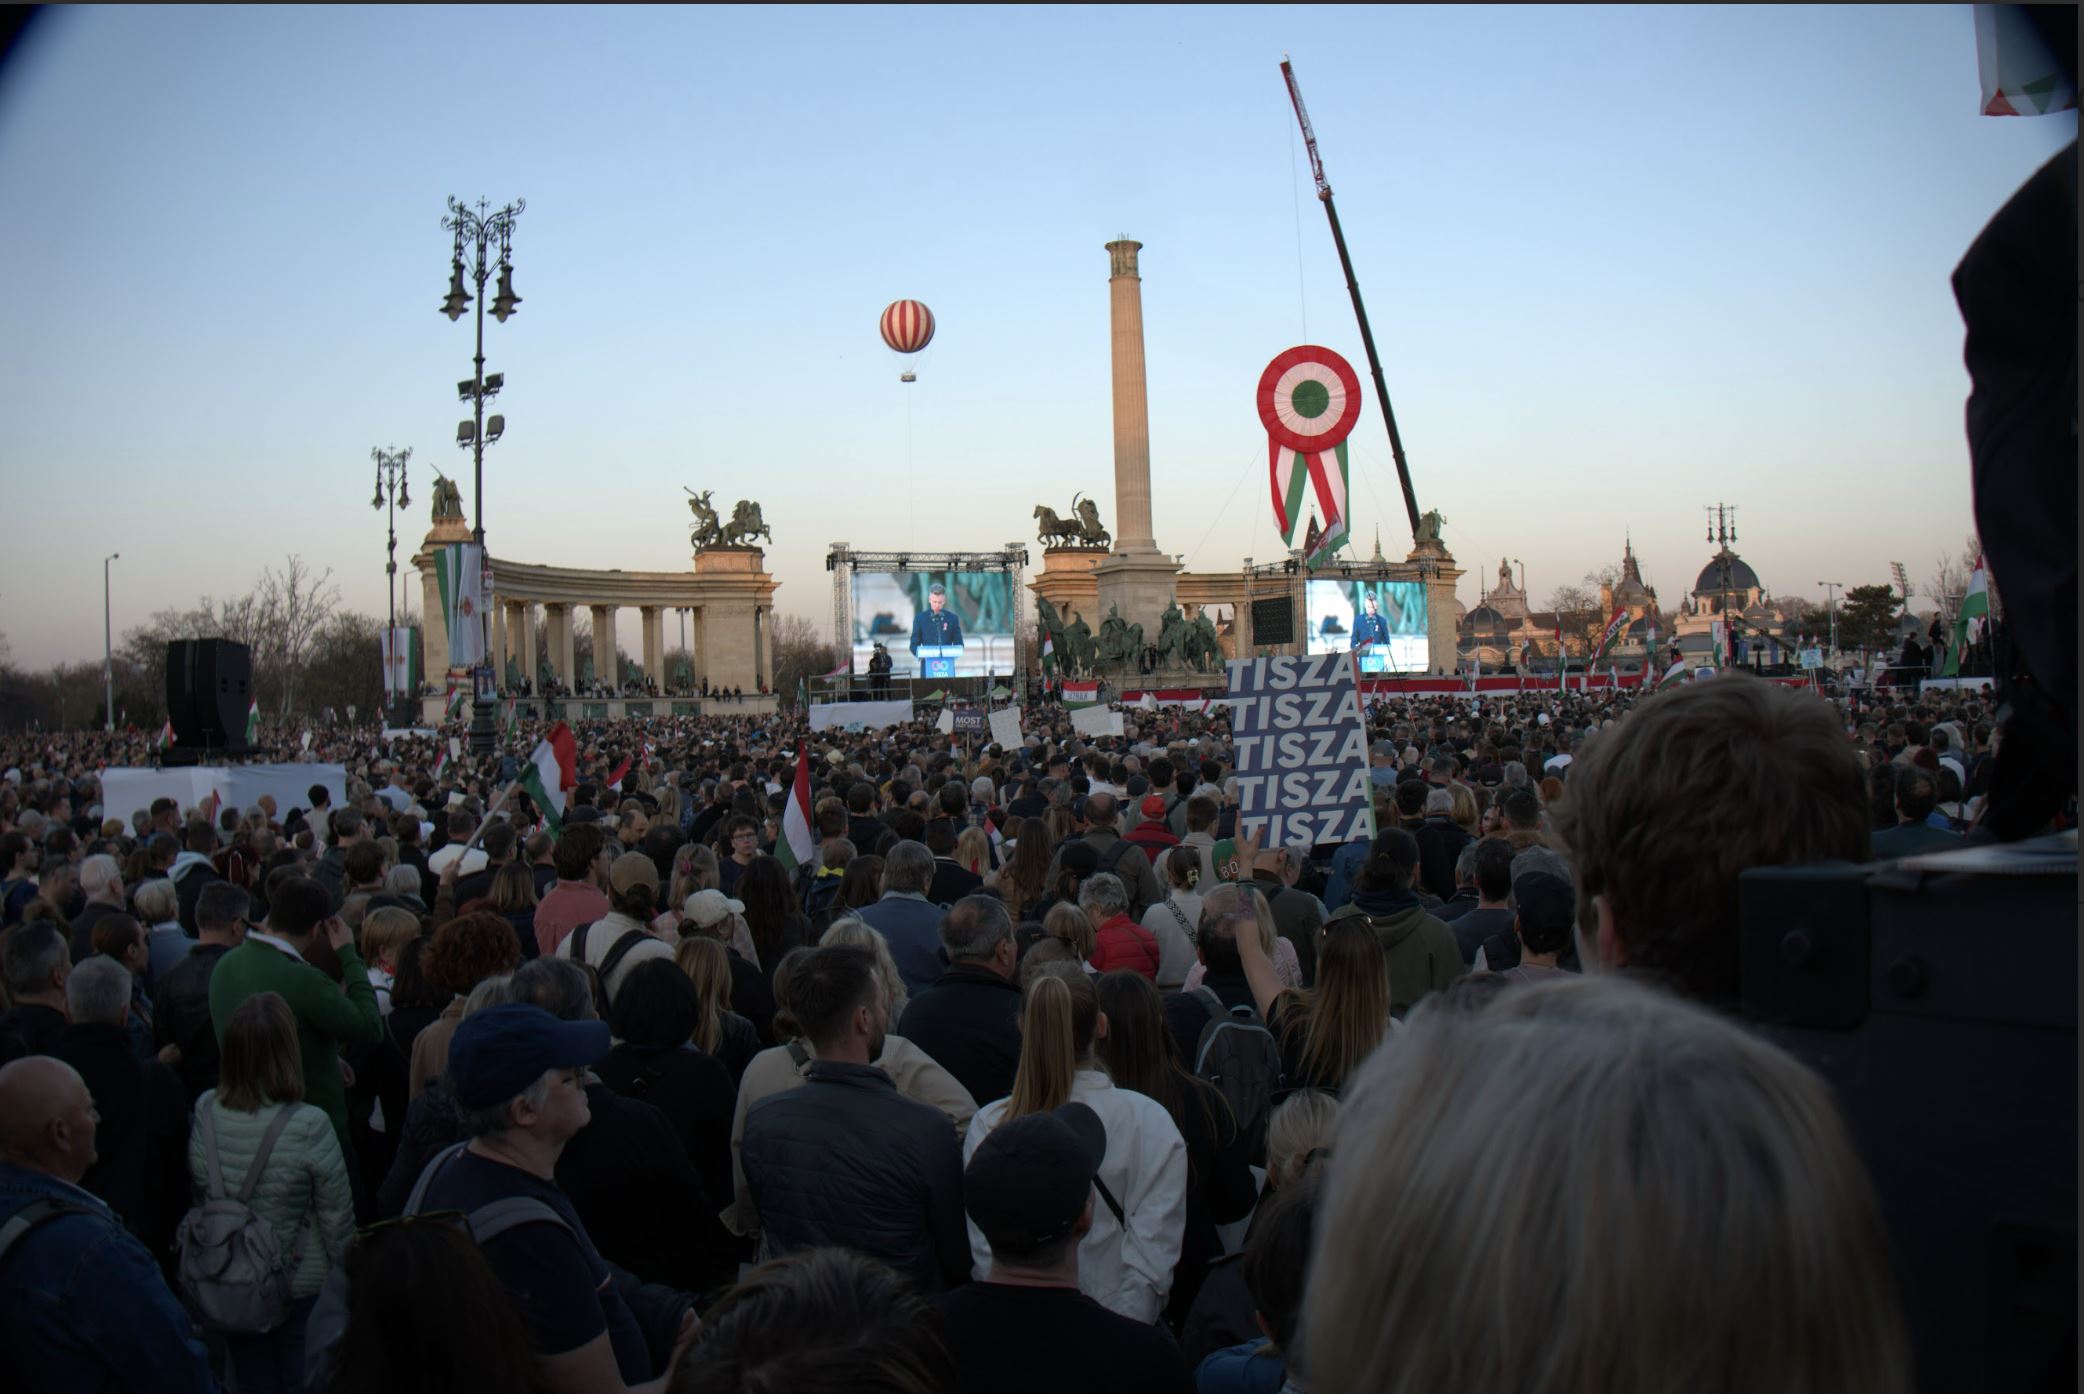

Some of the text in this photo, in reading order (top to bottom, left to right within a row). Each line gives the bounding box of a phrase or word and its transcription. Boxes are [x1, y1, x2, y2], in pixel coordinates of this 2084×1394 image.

[1225, 653, 1356, 692] TISZA
[955, 716, 981, 725] MOST
[1229, 690, 1362, 732] TISZA
[1233, 729, 1365, 771] TISZA
[1237, 768, 1369, 811] TISZA
[1241, 807, 1373, 848] TISZA
